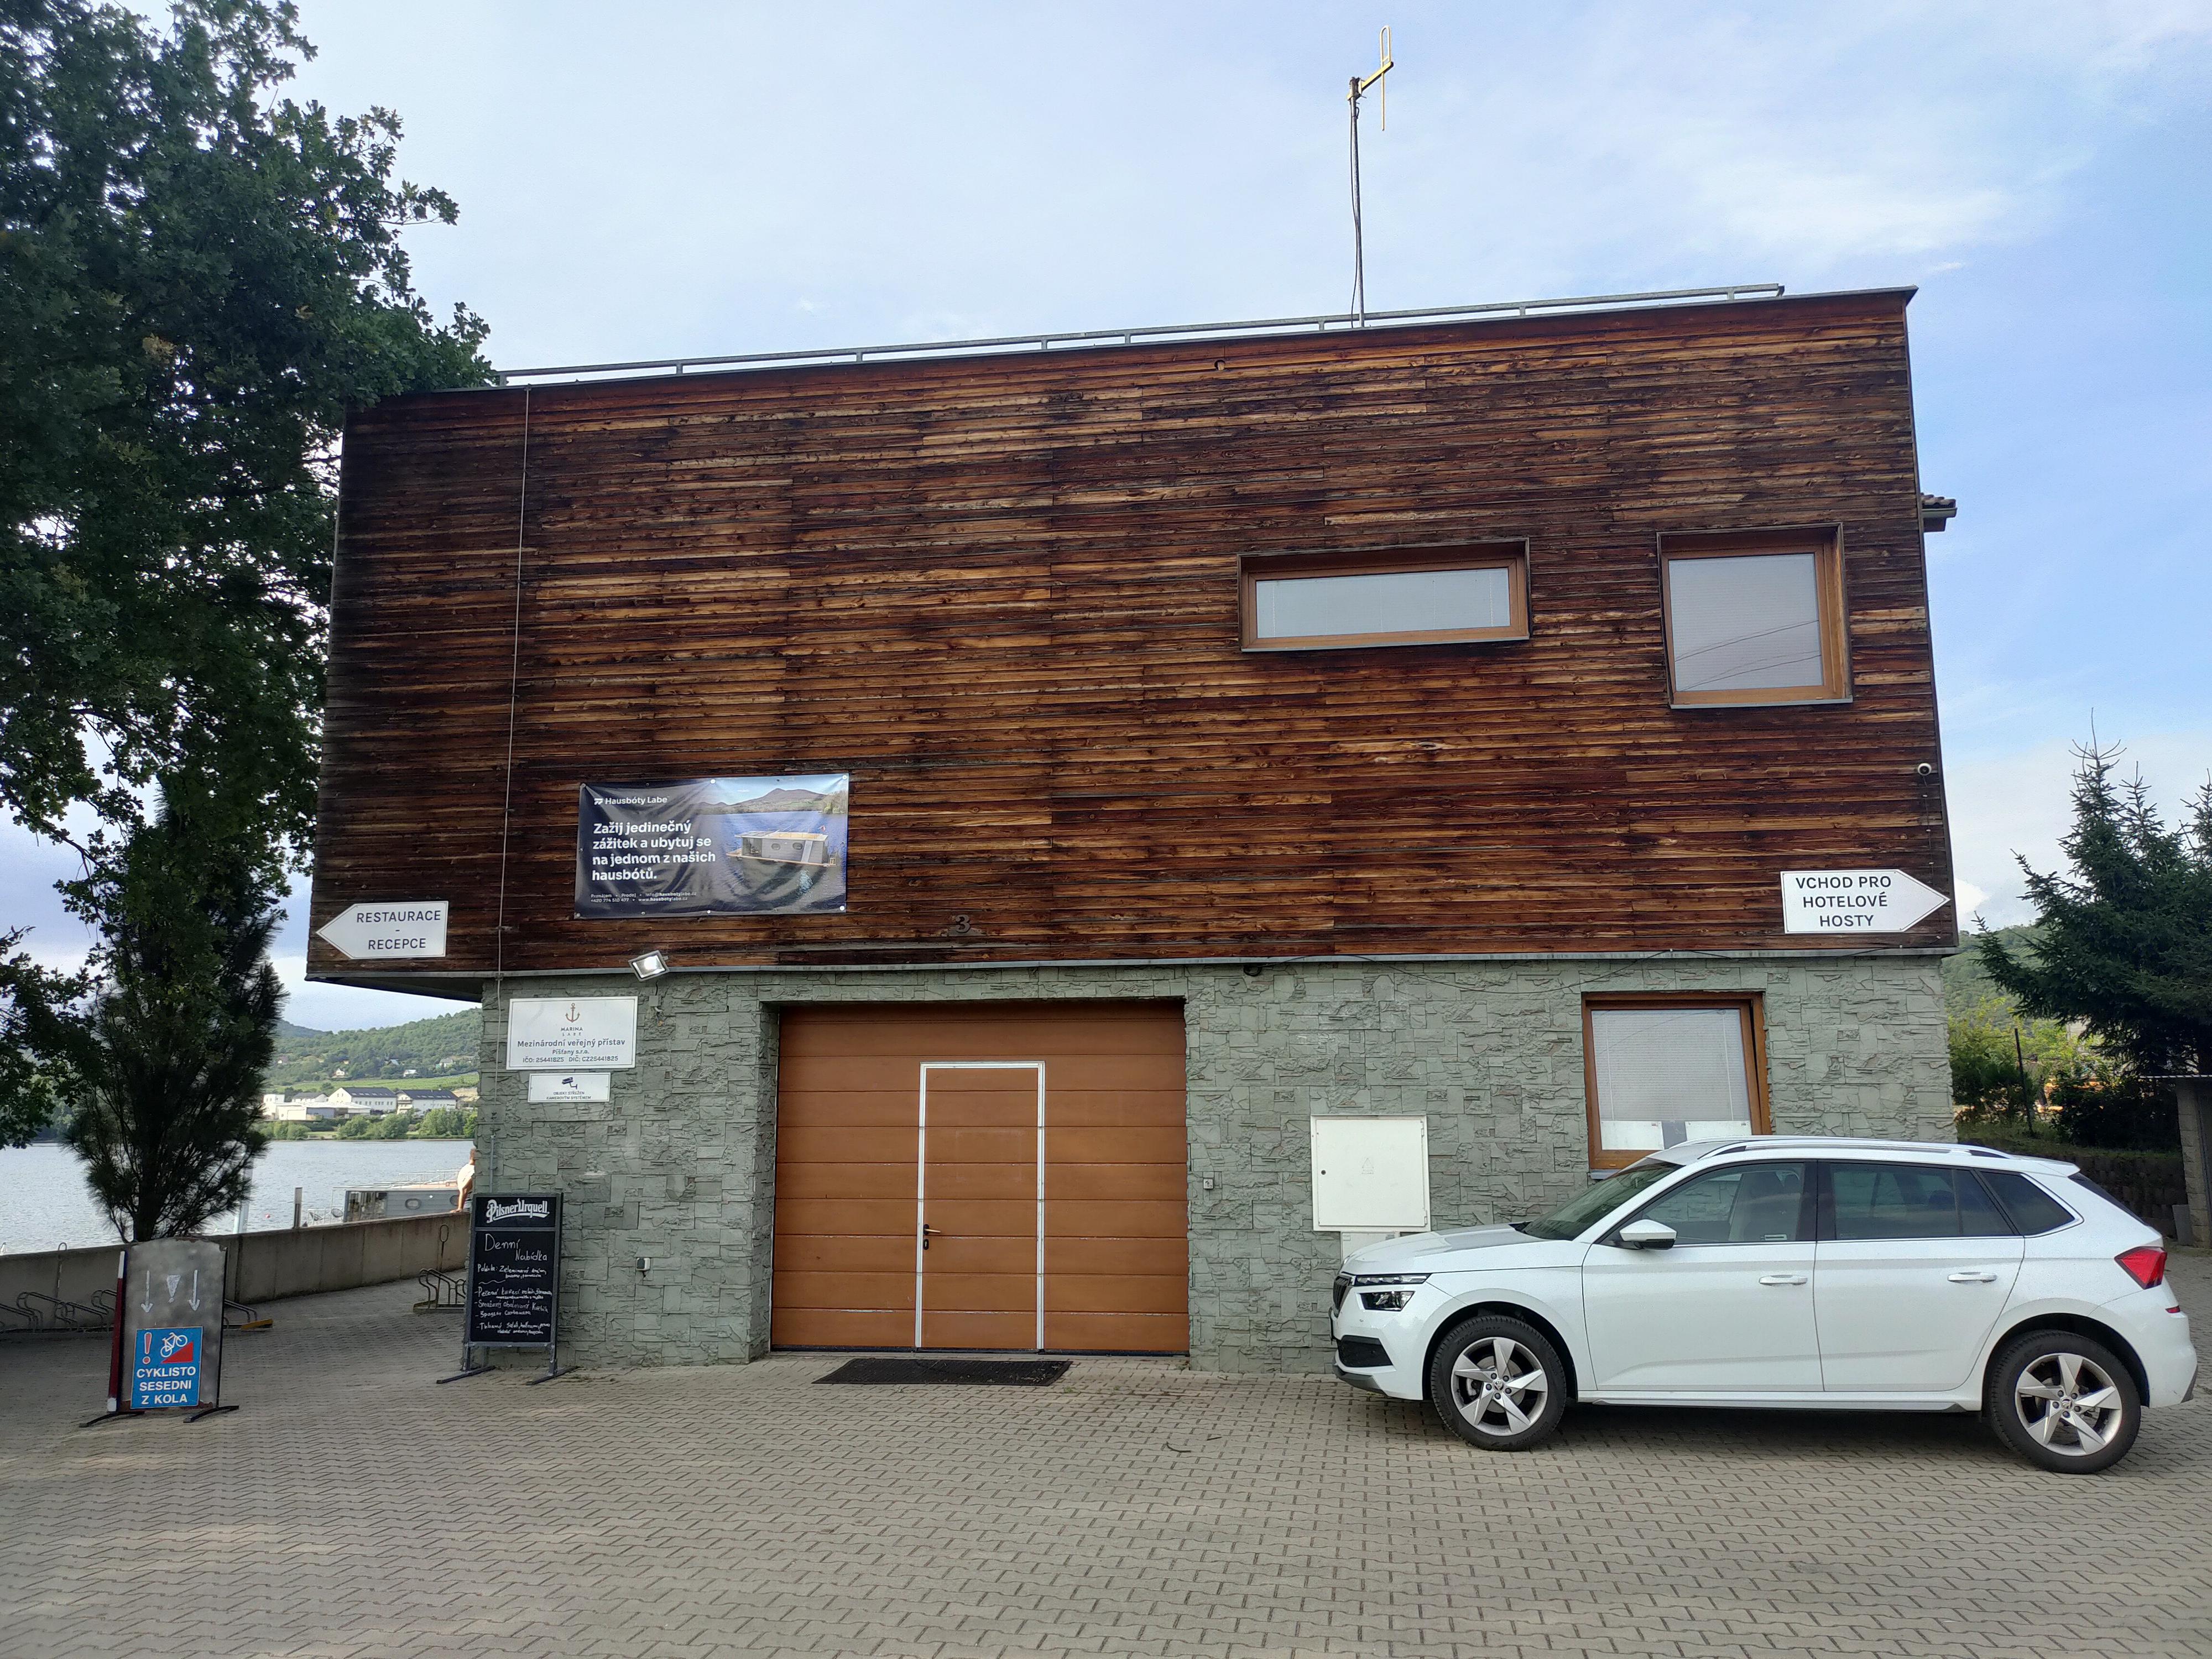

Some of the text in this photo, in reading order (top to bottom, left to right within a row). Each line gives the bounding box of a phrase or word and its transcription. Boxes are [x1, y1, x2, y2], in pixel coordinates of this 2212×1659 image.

[605, 796, 646, 805] Hausbóty
[593, 820, 692, 836] Zažij jedinečný
[592, 837, 638, 849] zážitek
[650, 836, 694, 850] ubytuj
[696, 838, 712, 847] se
[592, 851, 716, 867] na jednom z našich
[592, 867, 658, 881] hausbótů.
[1796, 875, 1892, 889] VCHOD PRO
[1802, 891, 1888, 908] HOTELOVÉ
[357, 910, 441, 923] RESTAURACE
[1819, 915, 1874, 927] HOSTY
[368, 938, 426, 950] RECEPCE
[518, 1038, 625, 1048] Mezinárodní veřejný přístav
[486, 1198, 550, 1223] Pilsner Urquell
[484, 1233, 521, 1251] Denní
[515, 1249, 547, 1261] Nabídka
[136, 1366, 196, 1378] CYKLISTO
[139, 1380, 192, 1391] SESEDNI
[141, 1394, 188, 1405] Z KOLA
